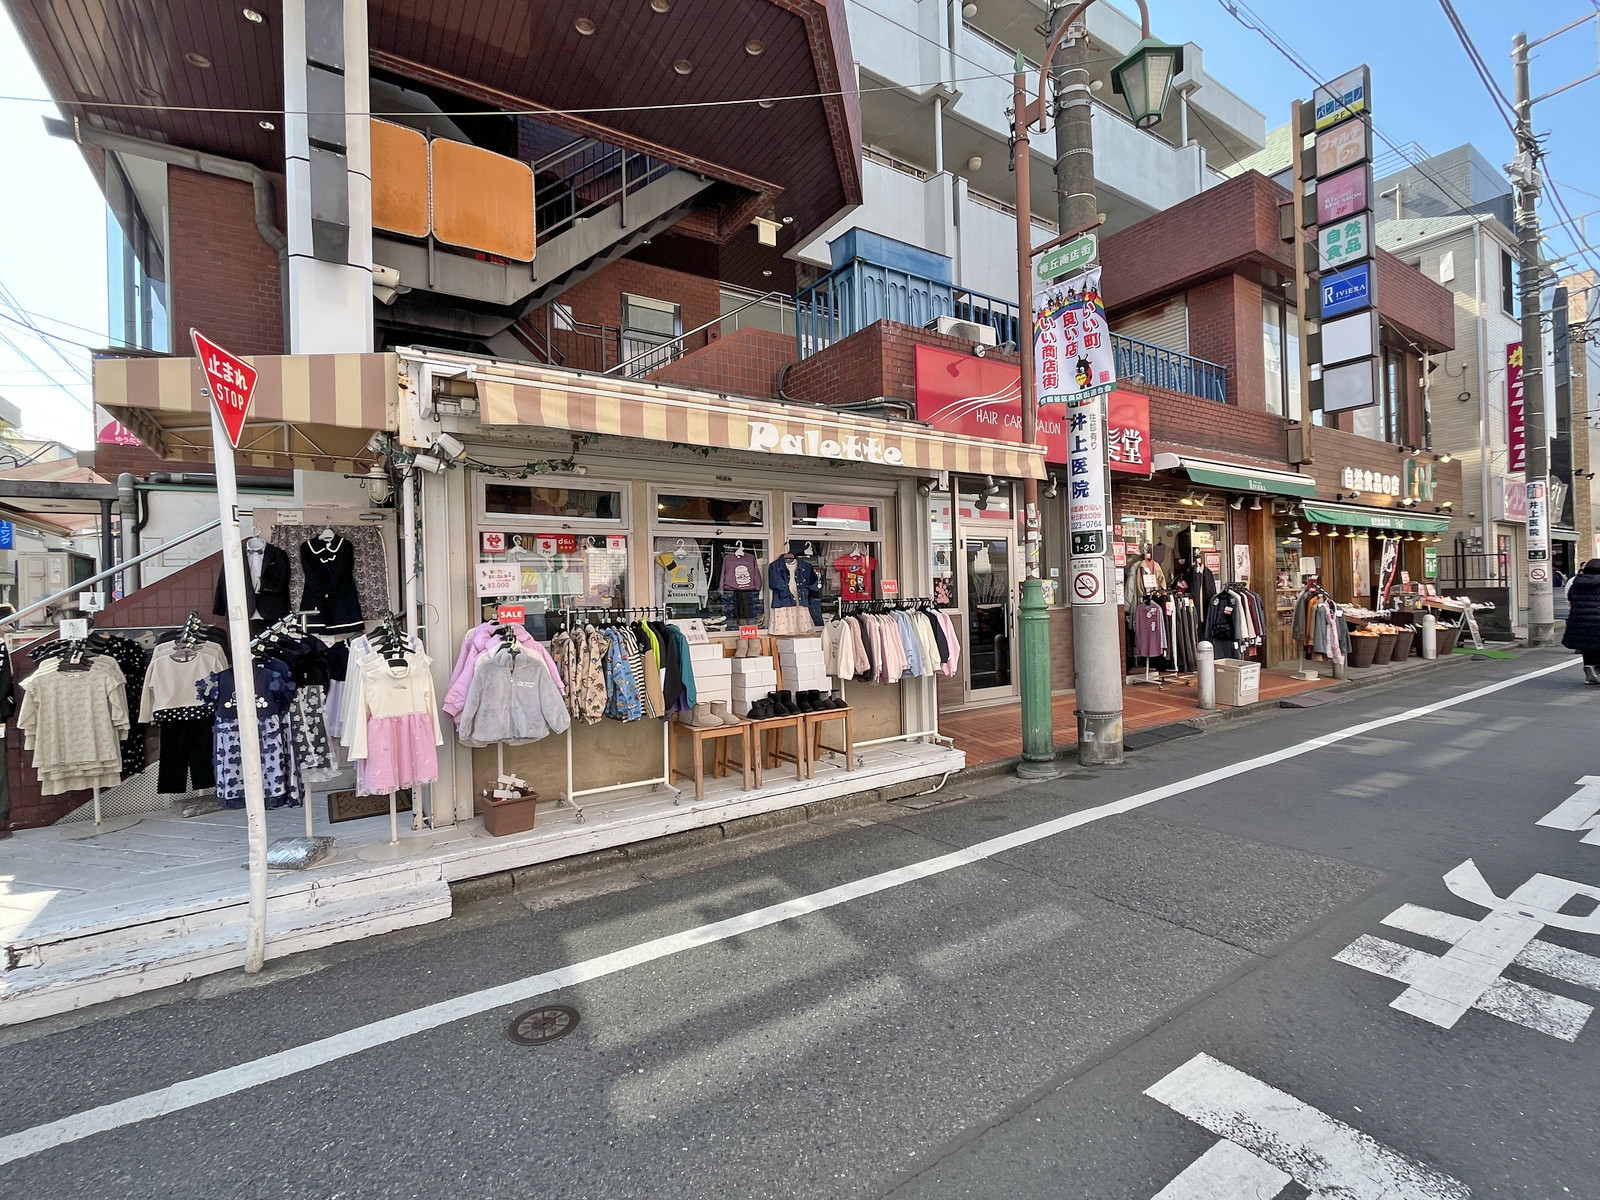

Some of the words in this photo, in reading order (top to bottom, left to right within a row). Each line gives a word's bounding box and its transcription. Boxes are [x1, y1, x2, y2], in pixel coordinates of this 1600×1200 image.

[1326, 237, 1361, 260] 食品
[1327, 220, 1361, 245] 自然
[1039, 242, 1092, 275] 梅丘商店街
[1062, 311, 1079, 359] 良い店
[1082, 301, 1101, 350] いい町
[1040, 317, 1058, 390] いい商店街
[207, 354, 248, 390] 止まれ
[217, 382, 245, 411] STOP
[976, 409, 998, 425] HAIR
[1004, 414, 1022, 429] CAR
[1089, 413, 1098, 450] 往診有り
[747, 421, 905, 466] Palette
[1069, 413, 1090, 499] 井上医院
[1343, 466, 1400, 496] 自然食品の店
[1529, 501, 1540, 536] 井上医院
[1076, 544, 1096, 552] 1-20
